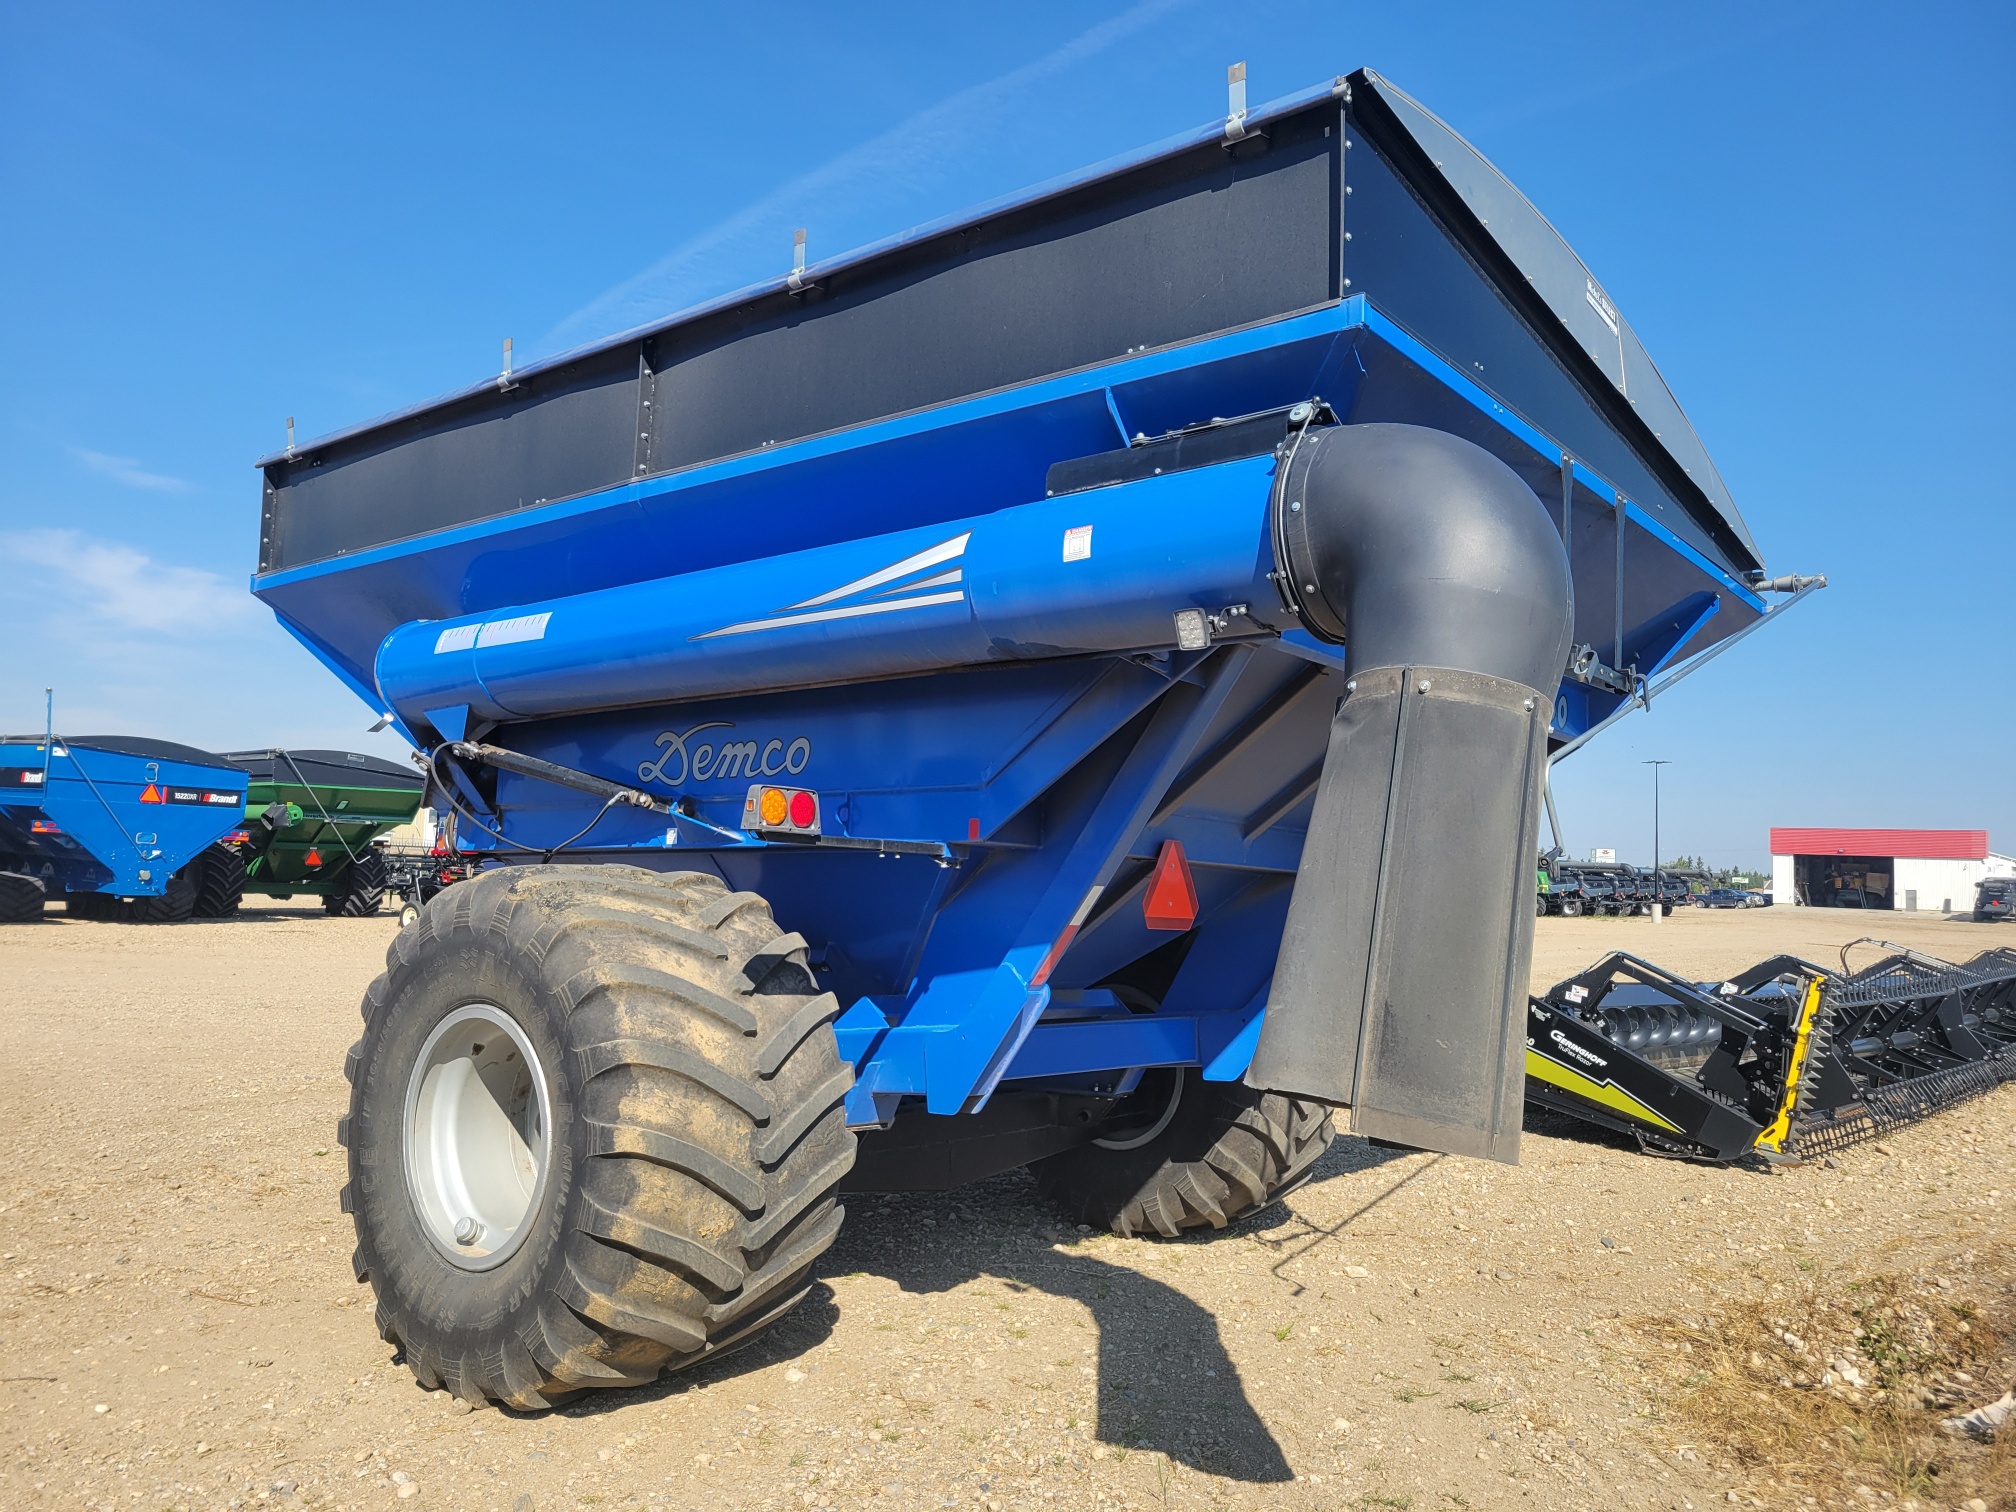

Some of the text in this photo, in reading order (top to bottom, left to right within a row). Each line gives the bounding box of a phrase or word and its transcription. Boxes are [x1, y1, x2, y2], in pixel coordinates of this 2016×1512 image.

[637, 721, 812, 787] Demco
[209, 793, 238, 804] Brandt
[1550, 1029, 1608, 1067] GERINGHOFF
[1557, 1043, 1593, 1067] TruFlex Razor
